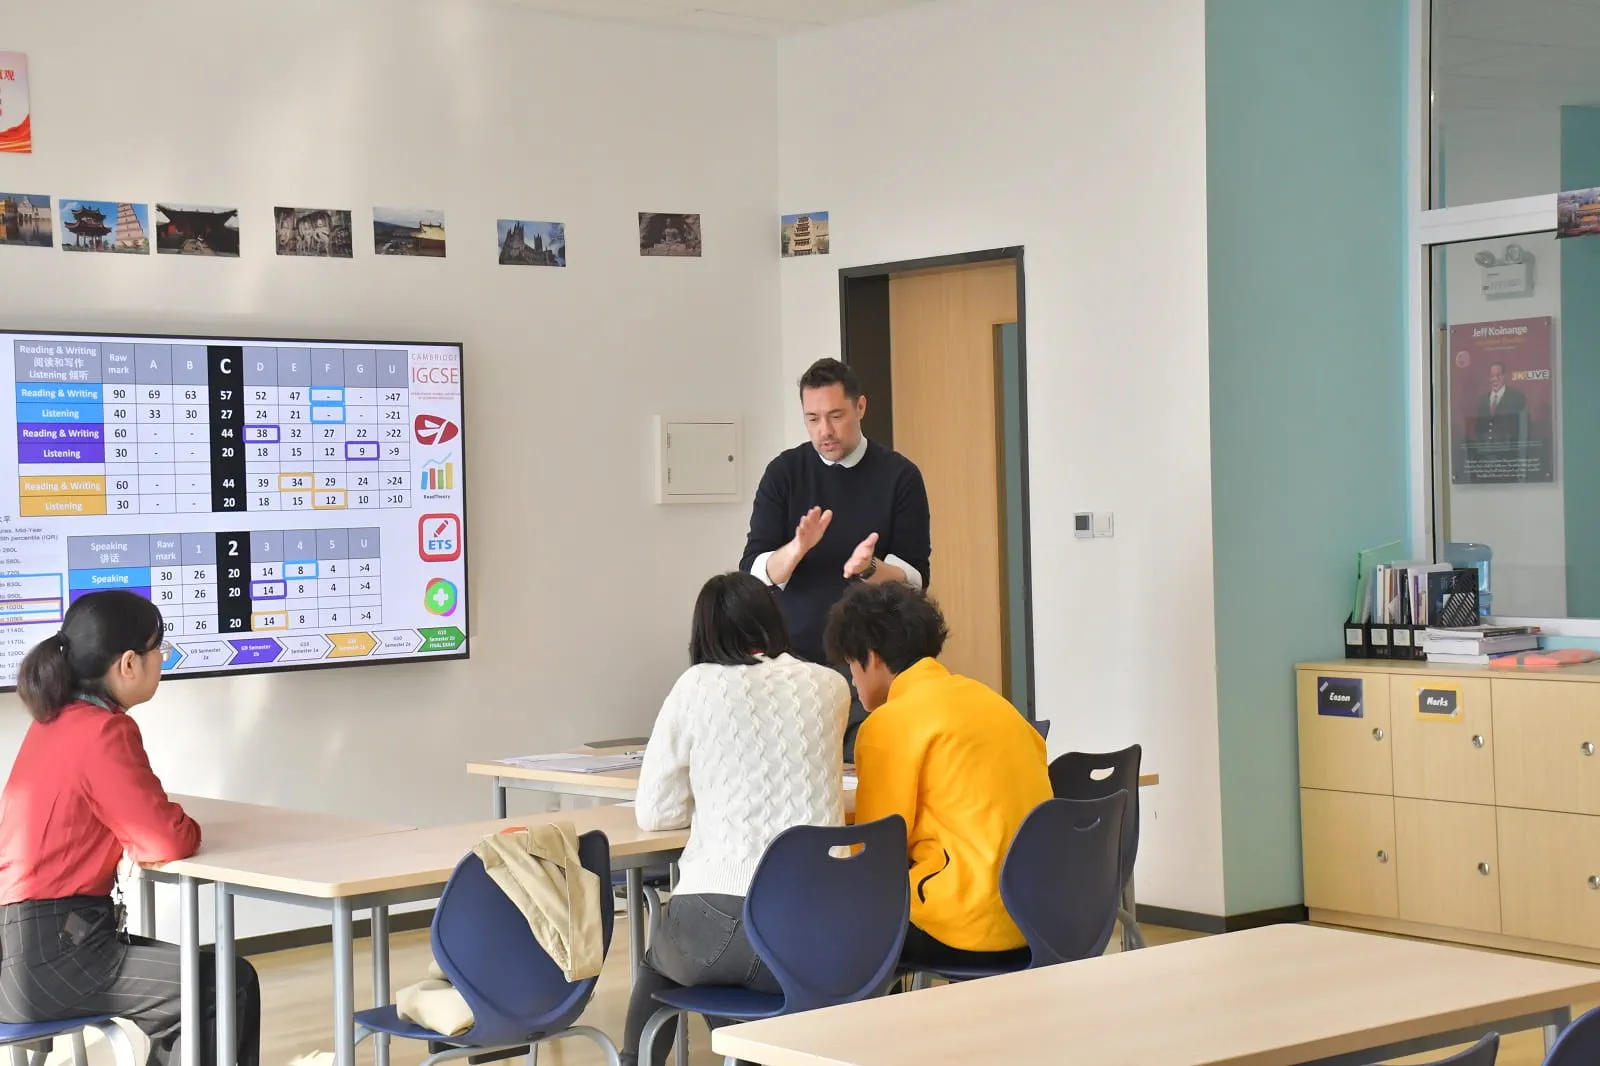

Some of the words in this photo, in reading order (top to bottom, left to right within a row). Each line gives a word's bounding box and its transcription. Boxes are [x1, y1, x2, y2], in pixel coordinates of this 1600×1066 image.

[1472, 328, 1488, 338] Jeff
[1488, 326, 1528, 336] Koinange
[20, 346, 54, 355] Reading
[66, 347, 96, 356] Writing
[34, 358, 83, 368] 阅读和写作
[220, 358, 232, 374] C
[257, 363, 264, 371] D
[357, 364, 364, 373] G
[389, 365, 395, 374] U
[108, 366, 129, 374] mark
[29, 371, 67, 381] Listening
[412, 368, 459, 384] IGCSE
[22, 389, 56, 398] Reading
[67, 390, 98, 399] Writing
[220, 391, 232, 400] 57
[256, 392, 266, 400] 52
[289, 392, 300, 400] 47
[385, 393, 400, 401] >47
[42, 410, 79, 419] Listening
[221, 410, 233, 419] 27
[256, 410, 267, 418] 24
[290, 411, 300, 419] 21
[385, 411, 400, 420] >21
[23, 429, 57, 438] Reading
[68, 429, 99, 439] Writing
[222, 429, 234, 438] 44
[257, 430, 268, 438] 38
[291, 430, 301, 438] 32
[324, 430, 334, 438] 27
[357, 430, 367, 438] 22
[386, 430, 401, 438] >22
[43, 449, 80, 459] Listening
[222, 448, 234, 457] 20
[258, 448, 268, 456] 18
[292, 448, 301, 456] 15
[325, 448, 334, 456] 12
[360, 448, 364, 456] 9
[389, 448, 399, 456] >9
[25, 482, 58, 491] Reading
[70, 482, 100, 491] Writing
[223, 479, 234, 488] 44
[258, 479, 268, 487] 39
[292, 479, 302, 487] 34
[325, 478, 335, 486] 29
[358, 477, 368, 486] 24
[387, 477, 402, 485] >24
[45, 501, 82, 511] Listening
[223, 498, 235, 508] 20
[259, 498, 269, 506] 18
[293, 497, 302, 505] 15
[326, 496, 336, 505] 12
[358, 496, 368, 504] 10
[387, 495, 402, 503] >10
[91, 542, 128, 551] Speaking
[196, 545, 201, 554] 1
[228, 541, 239, 556] 2
[264, 542, 270, 551] 3
[297, 541, 303, 550] 4
[330, 540, 335, 549] 5
[361, 540, 367, 548] U
[428, 540, 452, 550] ETS
[100, 553, 119, 563] 讲话
[156, 552, 176, 560] mark
[92, 574, 128, 584] Speaking
[160, 572, 172, 580] 30
[194, 571, 205, 579] 26
[228, 569, 240, 578] 20
[262, 568, 273, 576] 14
[298, 566, 303, 575] 8
[330, 565, 336, 574] 4
[359, 564, 370, 573] >4
[161, 592, 172, 600] 30
[194, 590, 206, 598] 26
[229, 588, 240, 597] 20
[263, 586, 274, 594] 14
[298, 585, 304, 594] 8
[331, 583, 336, 592] 4
[360, 582, 370, 591] >4
[162, 623, 174, 631] 30
[195, 621, 206, 630] 26
[230, 619, 241, 628] 20
[264, 617, 274, 626] 14
[299, 615, 305, 624] 8
[331, 614, 337, 622] 4
[360, 612, 371, 620] >4
[1330, 692, 1350, 702] Eason
